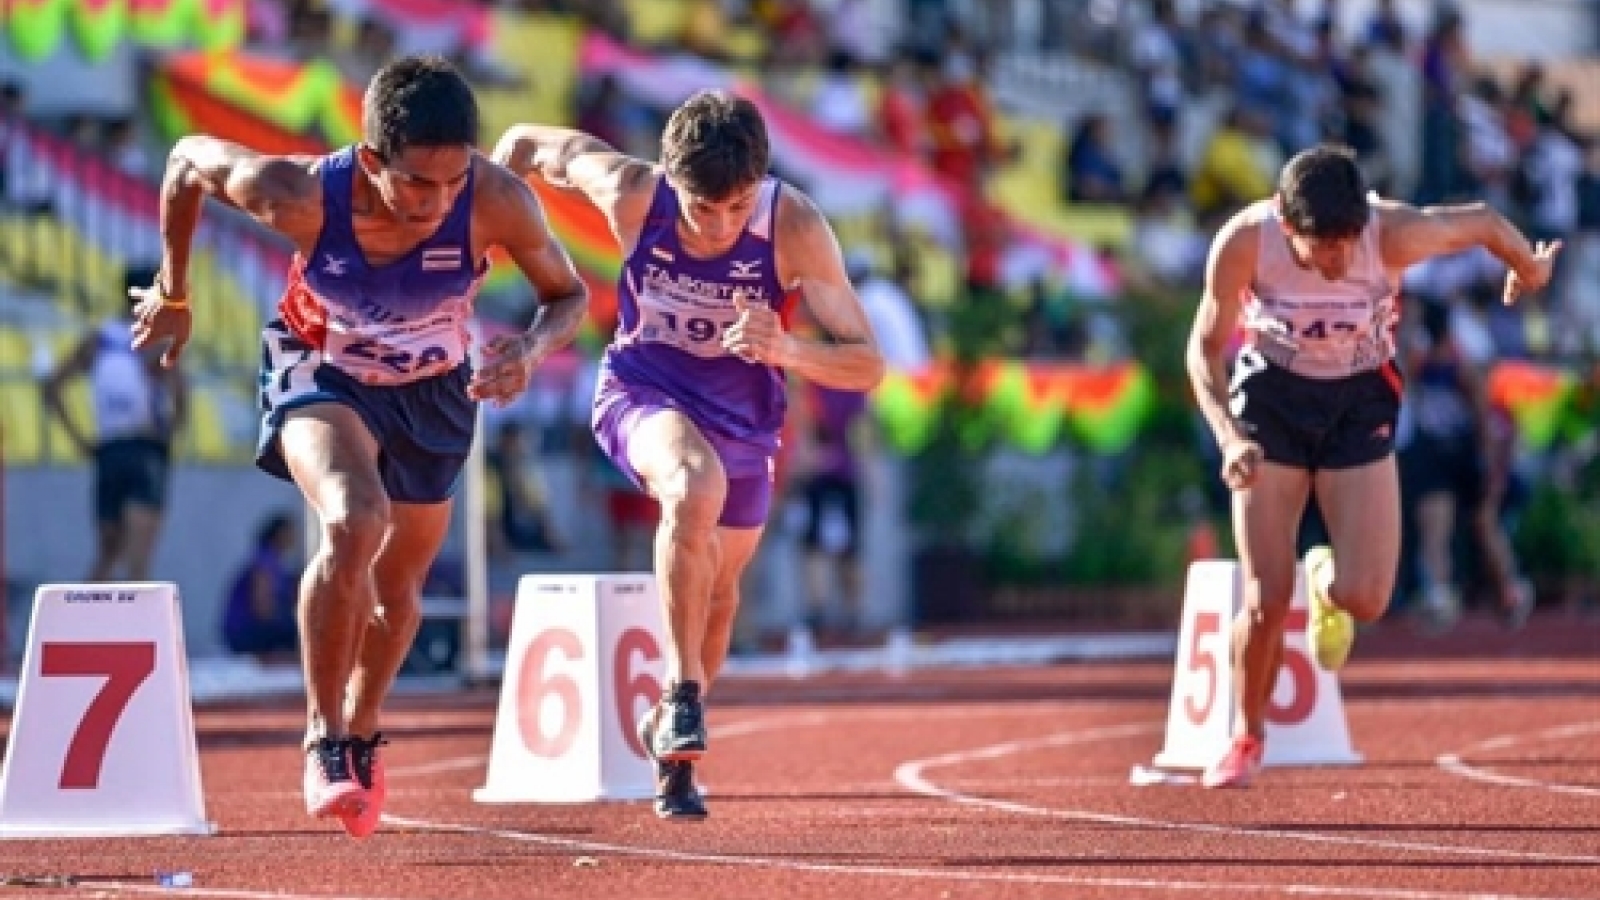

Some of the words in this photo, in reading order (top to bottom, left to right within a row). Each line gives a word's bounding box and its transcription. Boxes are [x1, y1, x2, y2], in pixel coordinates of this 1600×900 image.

[41, 641, 157, 790] 7
[516, 625, 585, 760] 6
[612, 626, 664, 760] 6
[1184, 612, 1220, 727] 5
